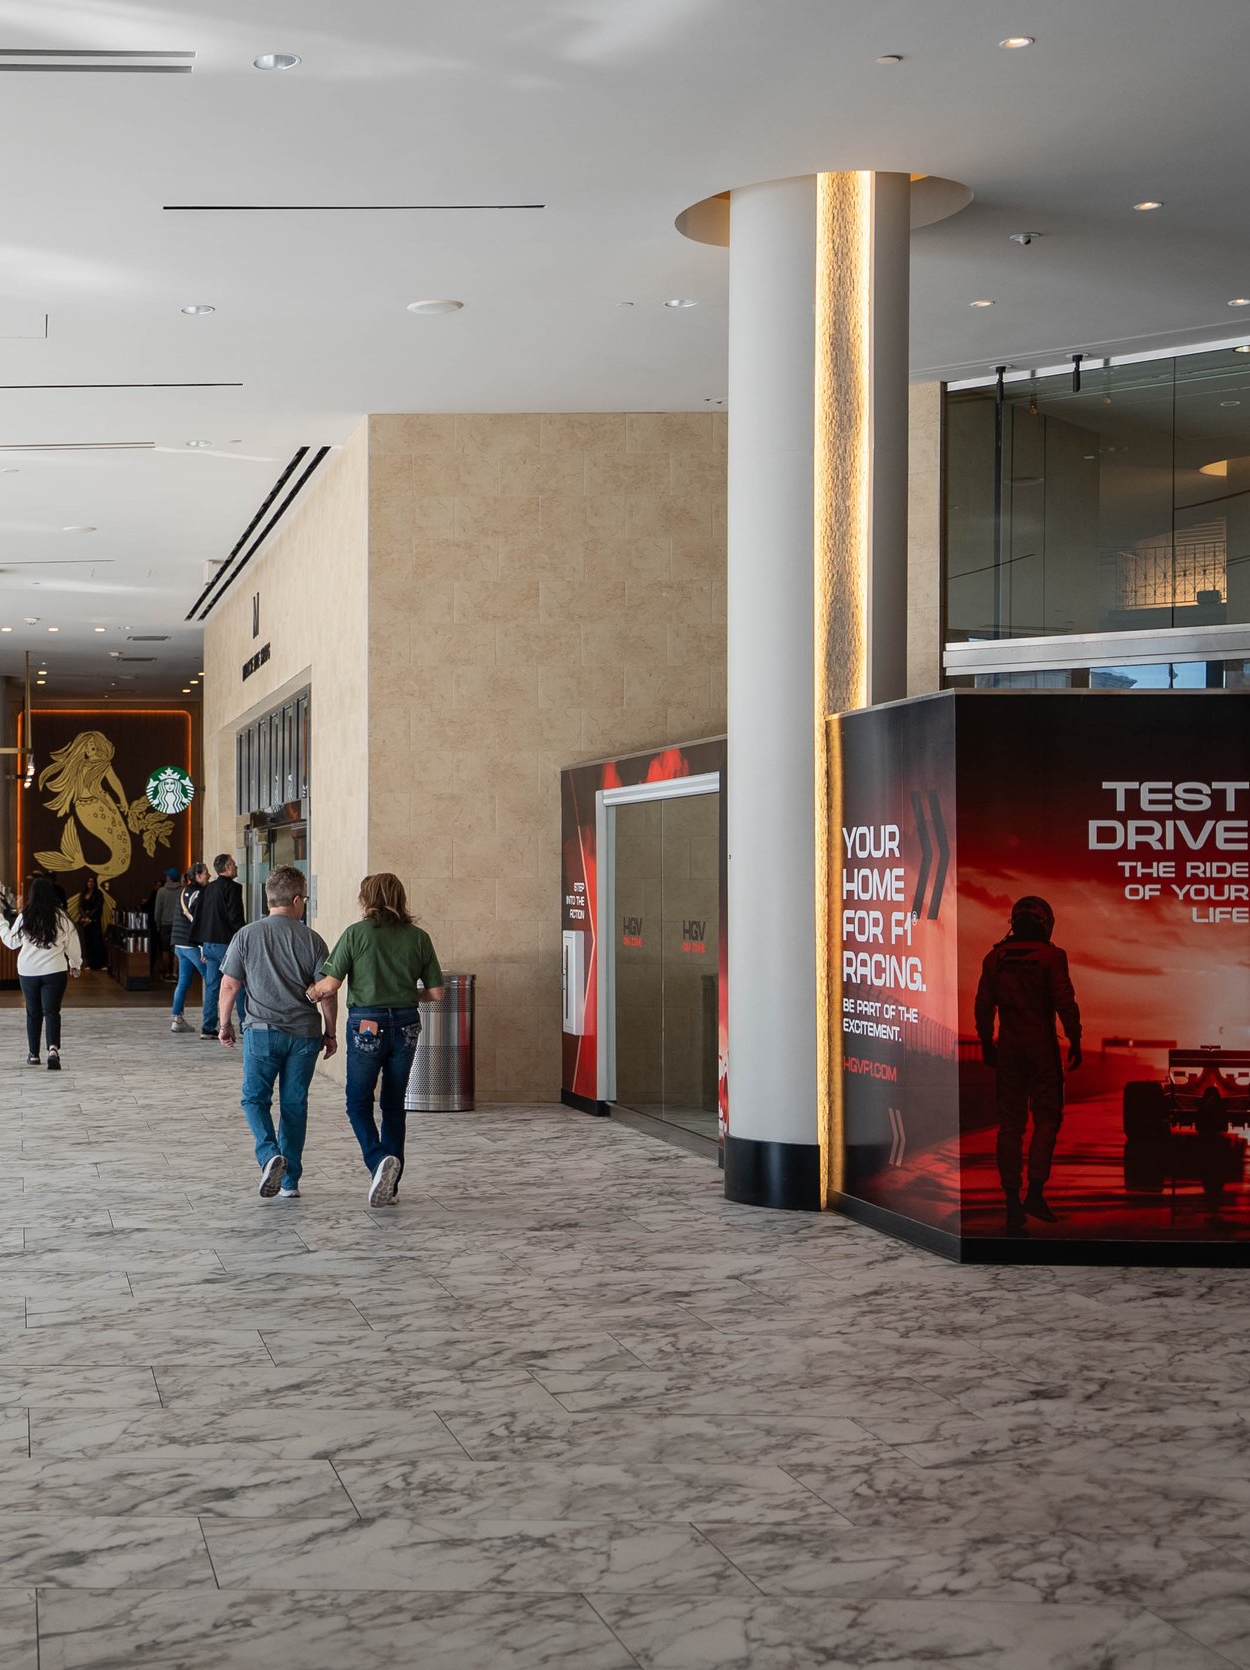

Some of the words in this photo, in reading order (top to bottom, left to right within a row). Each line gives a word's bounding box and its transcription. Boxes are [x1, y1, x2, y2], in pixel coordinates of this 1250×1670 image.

[1102, 781, 1250, 811] TEST
[842, 824, 900, 859] YOUR
[1088, 820, 1248, 850] DRIVE
[1117, 862, 1176, 878] THE
[1186, 862, 1249, 878] RIDE
[842, 867, 904, 902] HOME
[1124, 884, 1161, 900] OF
[1171, 884, 1249, 901] YOUR
[623, 916, 643, 936] HGV
[843, 909, 884, 944] FOR
[1192, 907, 1249, 923] LIFE
[682, 920, 706, 941] HGV
[843, 950, 927, 993] RACING.
[843, 997, 855, 1012] BE
[856, 1001, 881, 1017] PART
[883, 1003, 896, 1019] OF
[898, 1005, 919, 1023] THE
[843, 1018, 902, 1042] EXCITEMENT.
